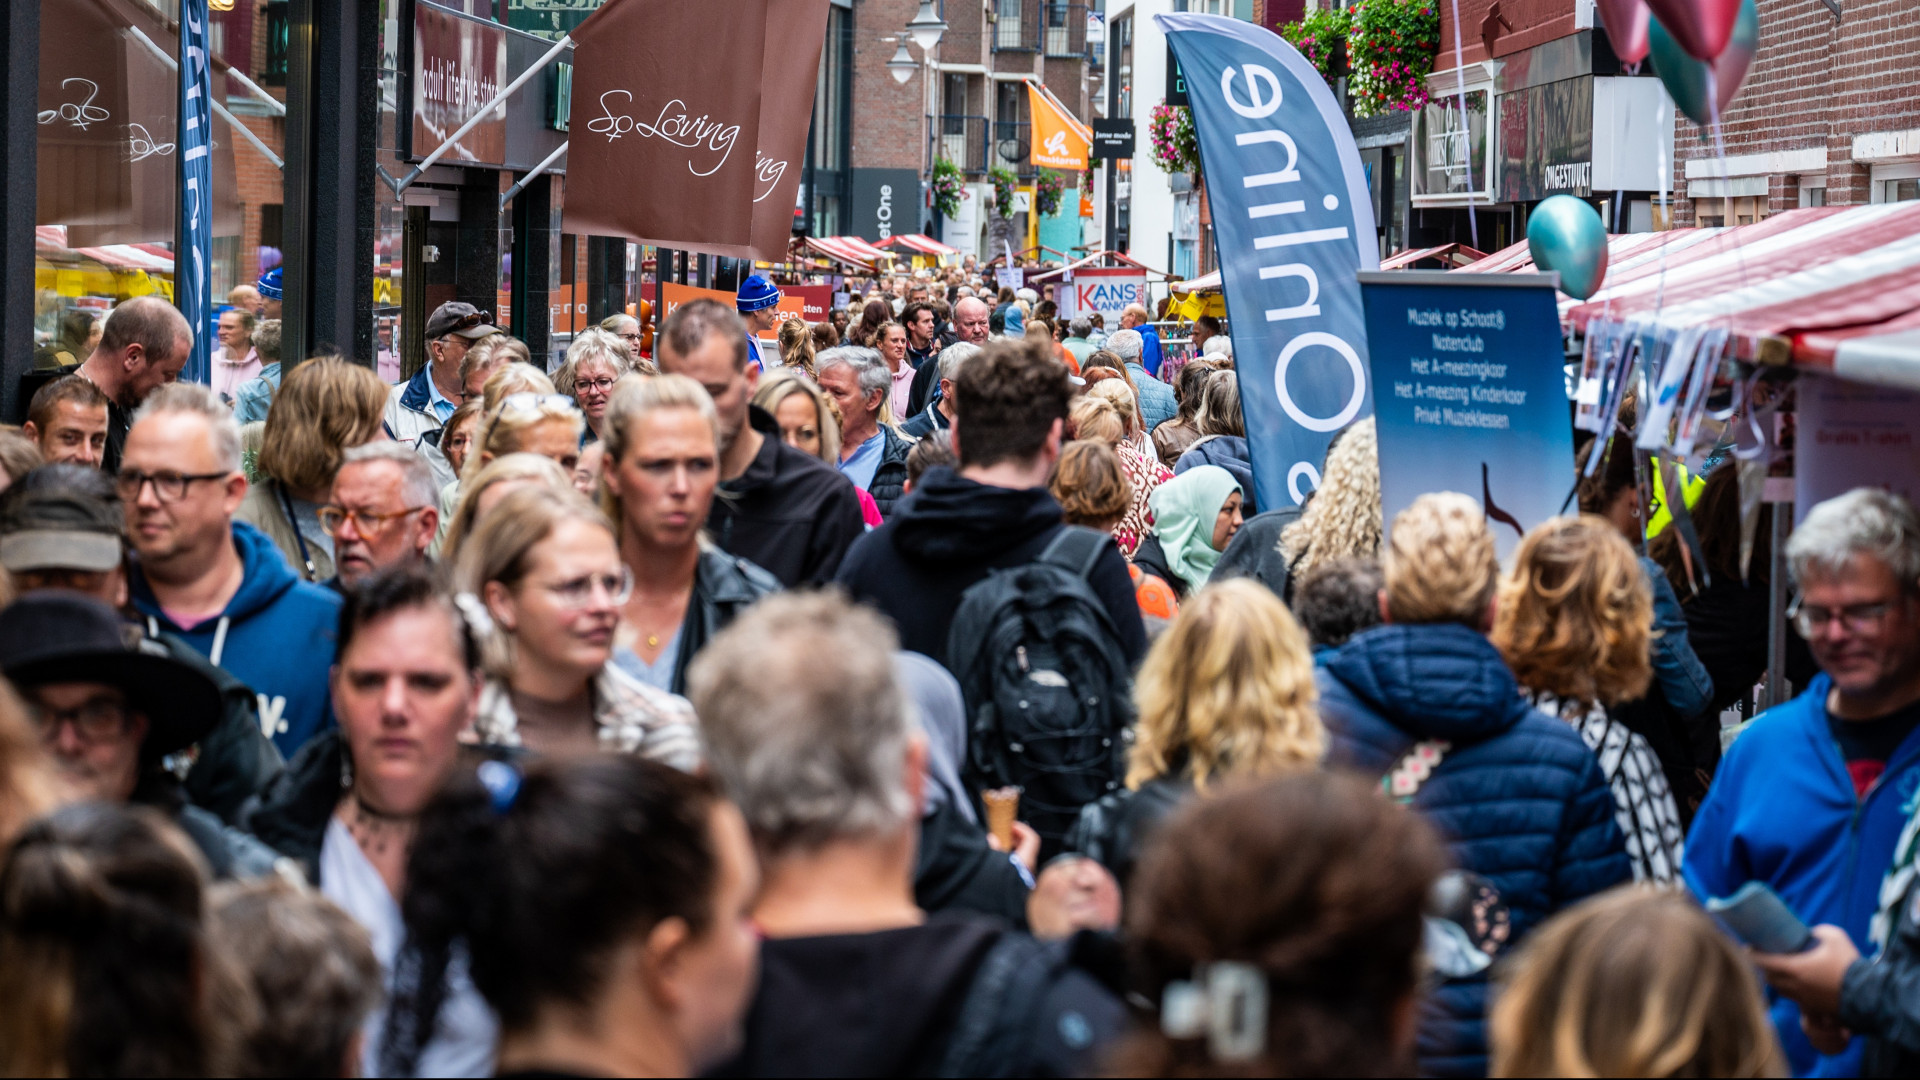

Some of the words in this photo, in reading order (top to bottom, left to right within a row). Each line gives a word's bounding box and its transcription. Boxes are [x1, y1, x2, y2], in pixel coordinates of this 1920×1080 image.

[423, 55, 443, 101] adult
[446, 60, 478, 118] lifestyle
[480, 75, 499, 112] store
[587, 89, 633, 143] So
[635, 99, 741, 177] Loving
[1077, 284, 1136, 312] KANS
[1407, 308, 1442, 326] Muziek
[1444, 311, 1459, 330] op
[1432, 333, 1484, 353] Notenclub
[1411, 358, 1429, 375] Het
[1394, 382, 1413, 398] Het
[1470, 384, 1527, 405] Kinderkoor
